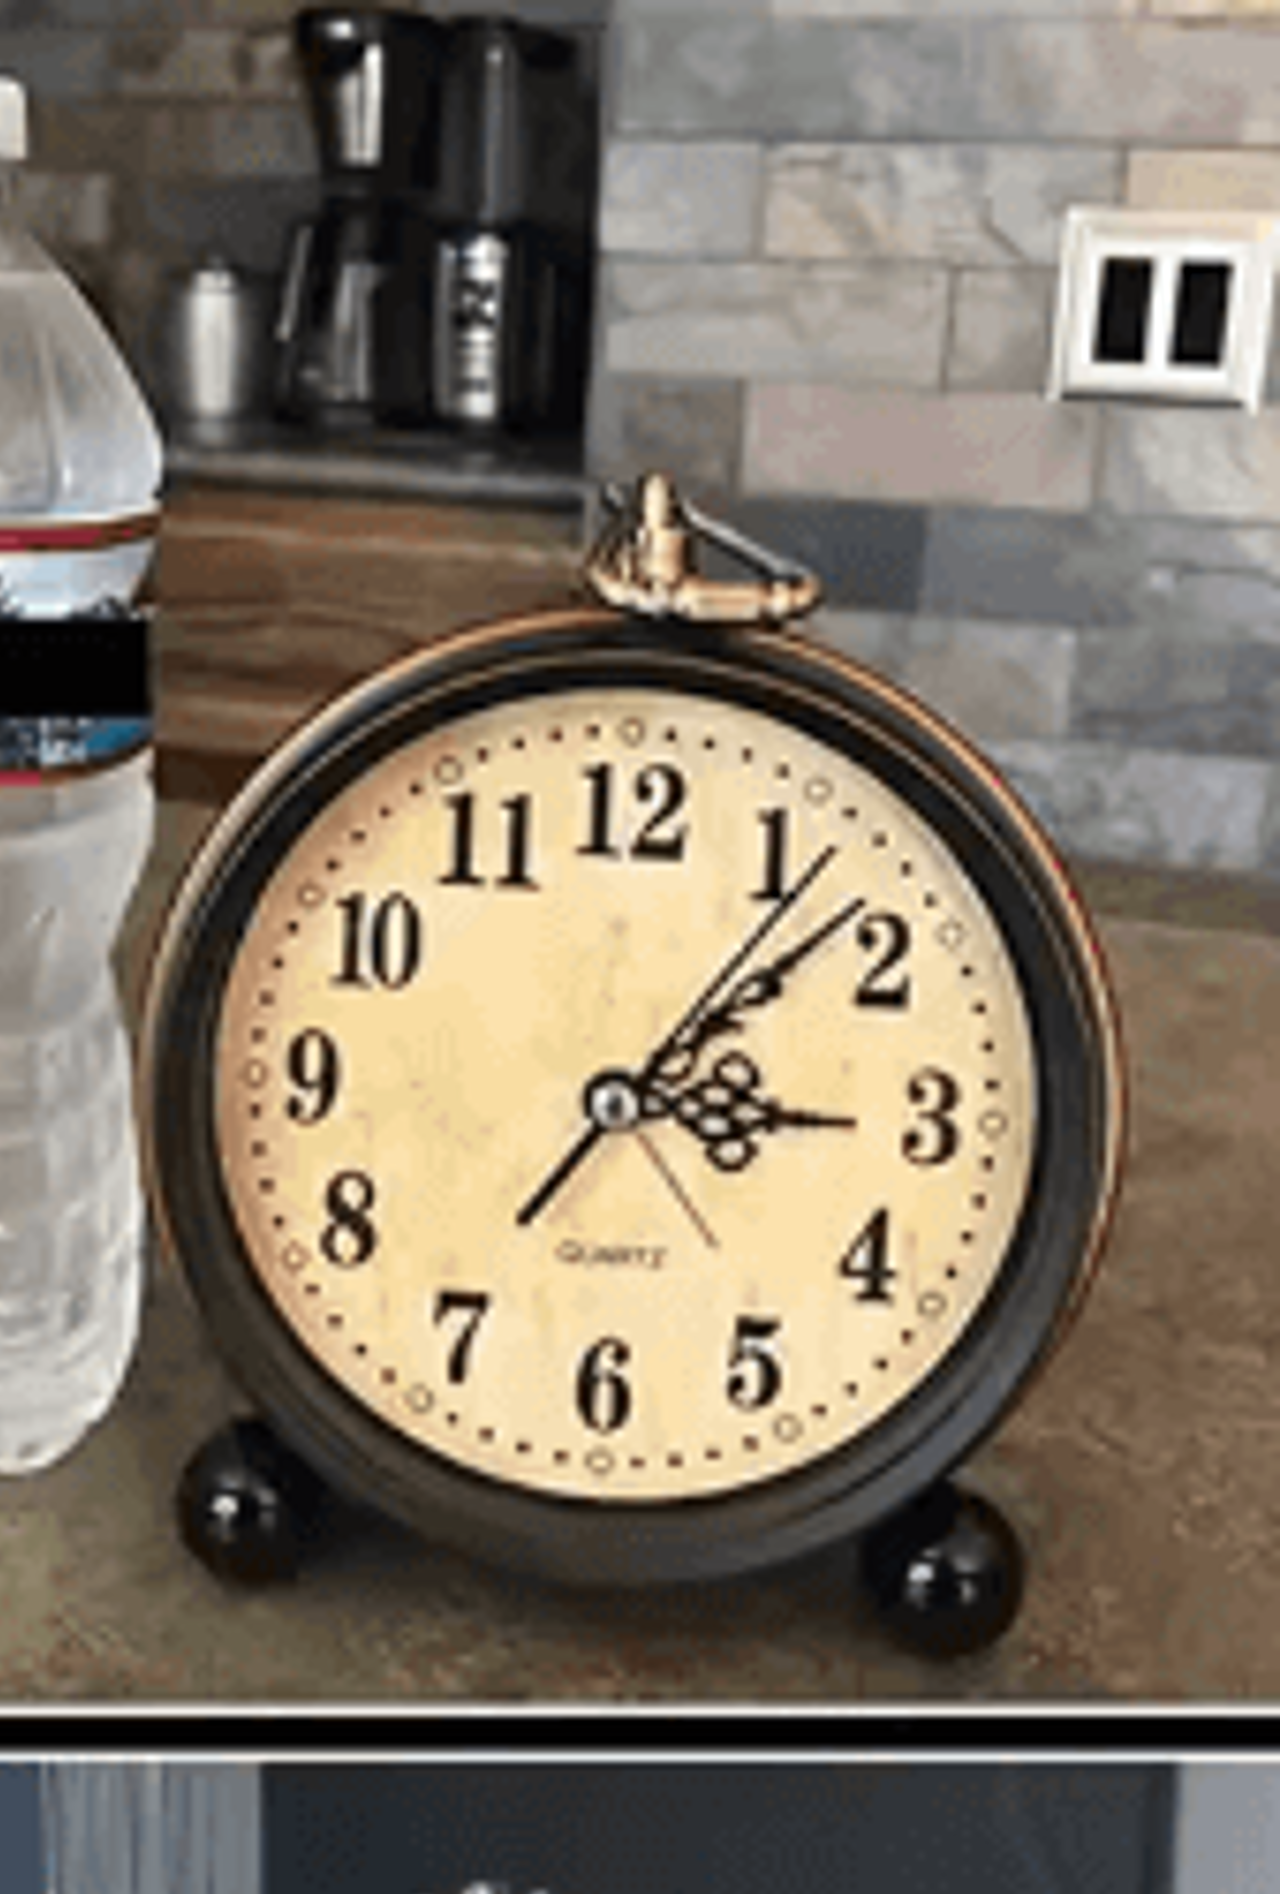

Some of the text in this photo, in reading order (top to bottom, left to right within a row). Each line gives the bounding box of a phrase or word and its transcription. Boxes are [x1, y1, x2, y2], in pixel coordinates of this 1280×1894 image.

[438, 792, 541, 891] 11
[576, 762, 691, 861] 12
[750, 808, 790, 902] 1
[332, 891, 422, 991] 10
[853, 912, 912, 1009] 2
[284, 1028, 340, 1126] 9
[901, 1068, 960, 1165] 3
[319, 1170, 378, 1268] 8
[556, 1240, 670, 1268] QUARTZ
[839, 1208, 896, 1305] 4
[432, 1290, 490, 1384] 7
[576, 1338, 631, 1432] 6
[726, 1315, 783, 1410] 5
